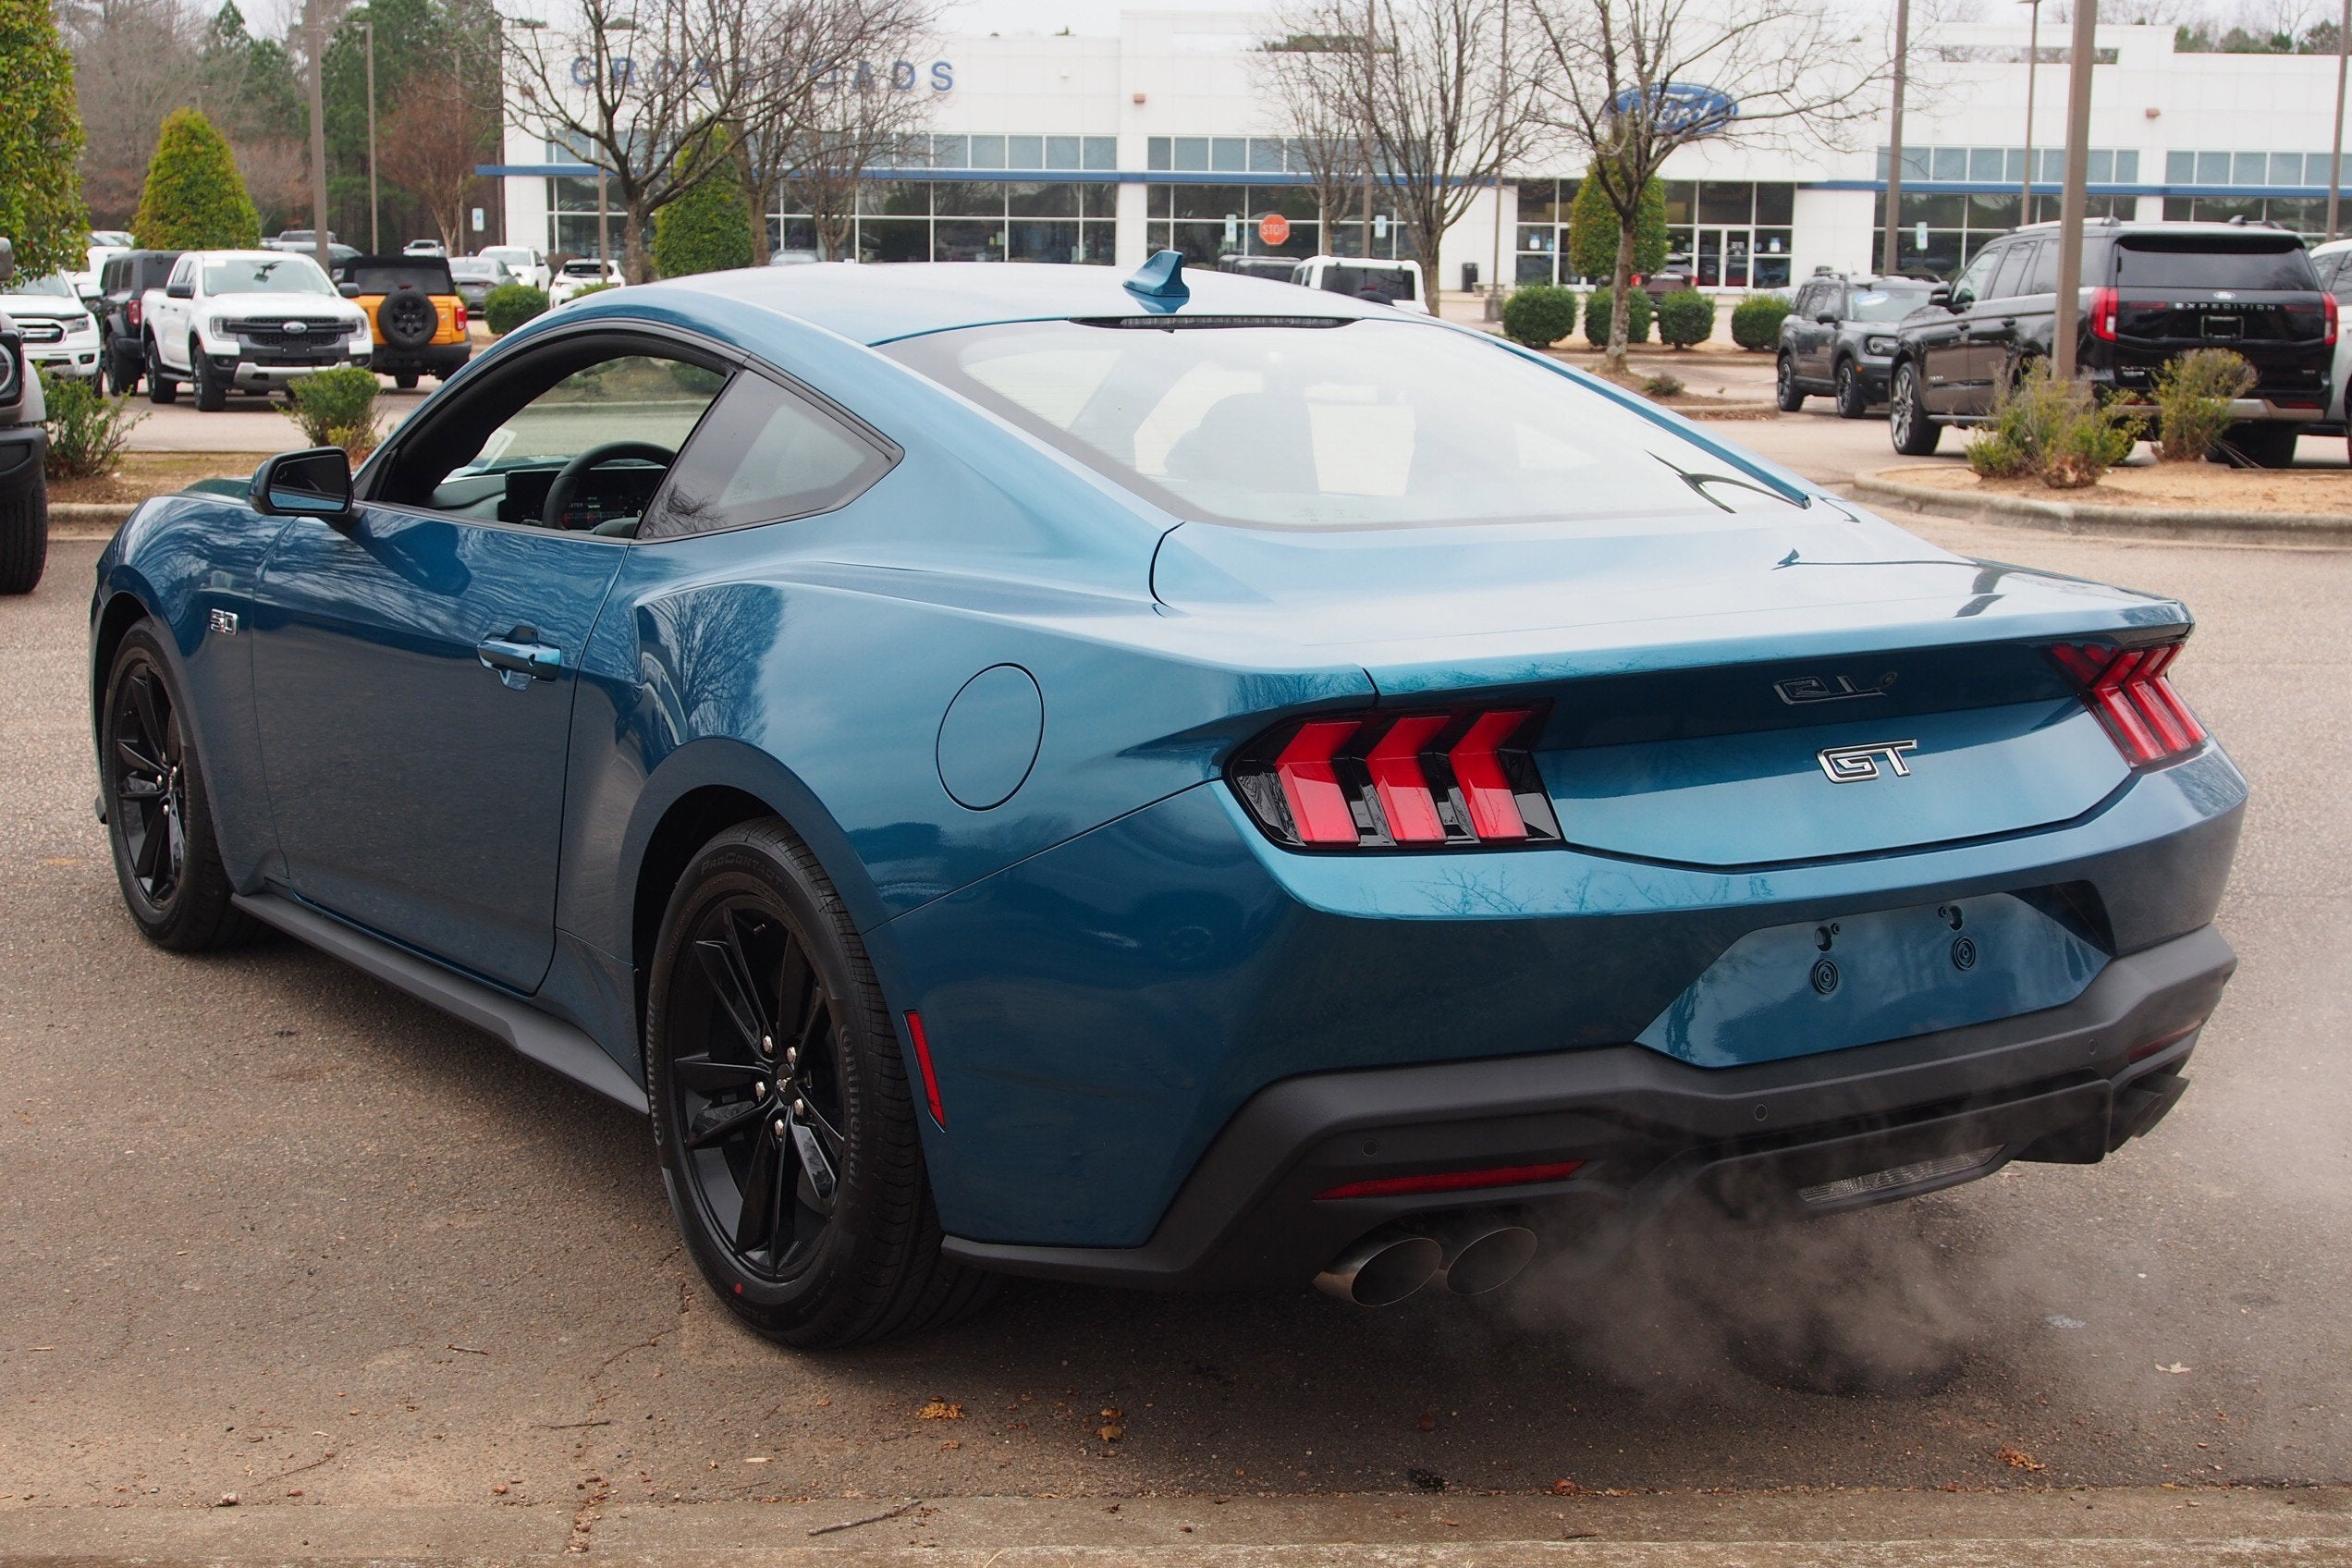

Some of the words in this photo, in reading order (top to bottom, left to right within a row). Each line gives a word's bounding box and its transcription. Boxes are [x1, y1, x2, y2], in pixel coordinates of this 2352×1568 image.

[1262, 224, 1286, 235] STOP
[2174, 302, 2276, 312] EXPEDITION
[1817, 738, 1918, 783] GT
[839, 1023, 864, 1191] Continental
